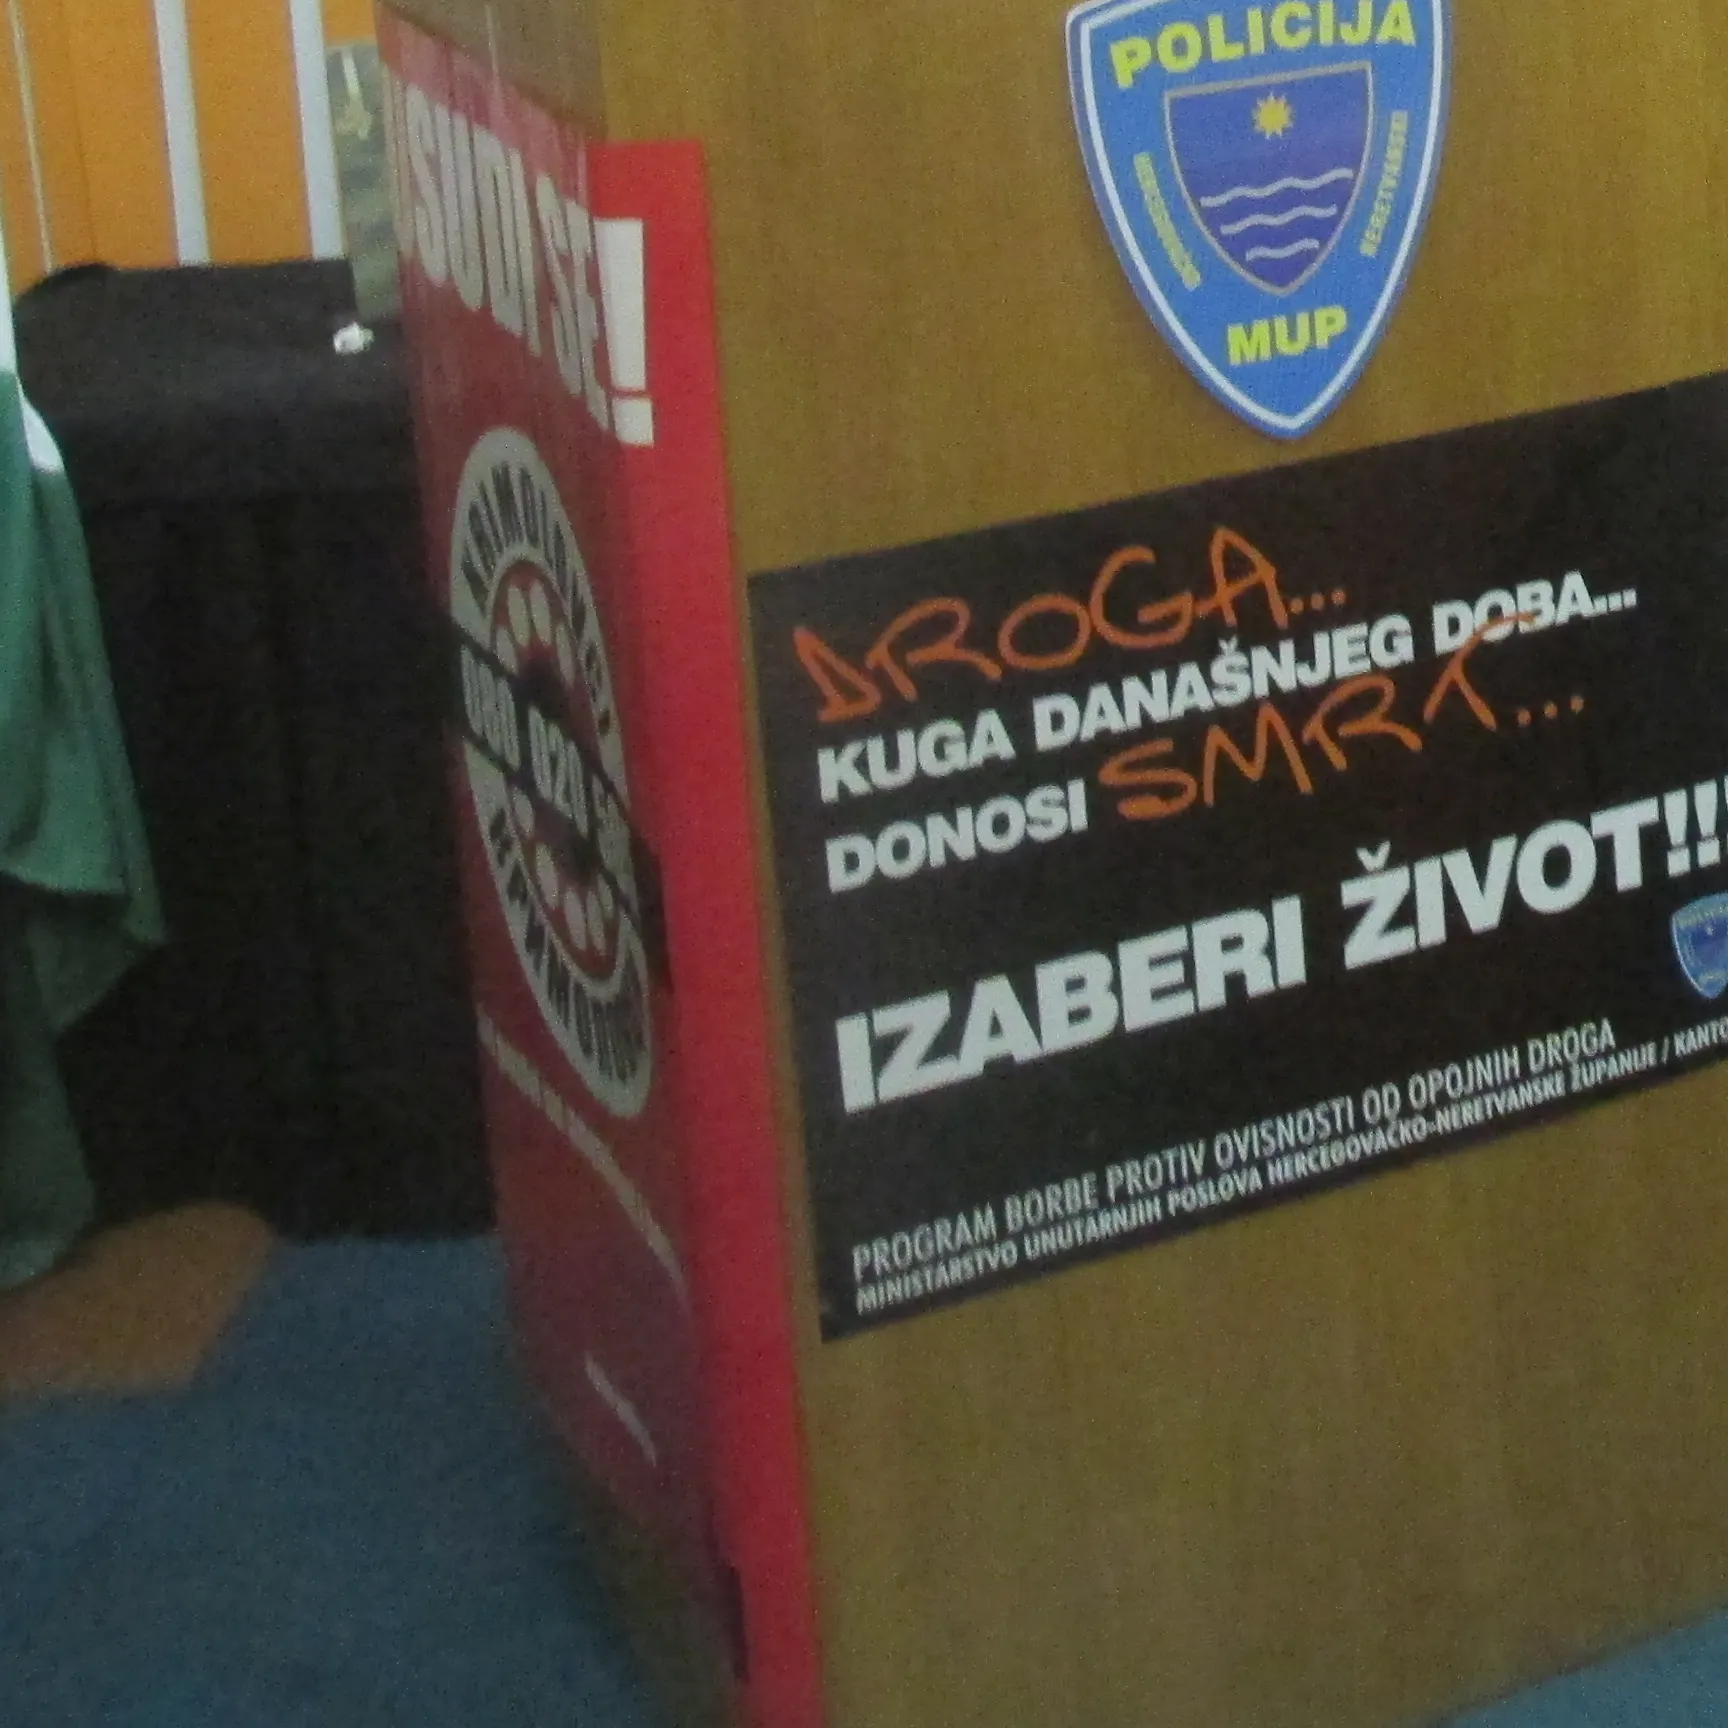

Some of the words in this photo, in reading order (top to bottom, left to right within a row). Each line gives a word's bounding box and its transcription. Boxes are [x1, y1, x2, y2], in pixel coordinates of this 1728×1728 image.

[1227, 305, 1347, 366] MUP
[817, 709, 1016, 804] KUGA
[1032, 613, 1416, 753] DANAŠNJEG
[1432, 570, 1639, 657] DOBA...
[825, 778, 1089, 893] DONOSI
[835, 893, 1307, 1115] IZABERI
[851, 1202, 998, 1282] PROGRAM
[1004, 1172, 1098, 1234] BORBE
[1105, 1139, 1206, 1204] PROTIV
[1213, 1095, 1355, 1171] OVISNOSTI
[1361, 1082, 1401, 1124] OD
[1407, 1044, 1520, 1109] OPOJNIH
[1526, 1017, 1616, 1073] DROGA
[855, 1239, 1018, 1316] MINISTARSTVO
[1167, 1168, 1263, 1217] POSLOVA
